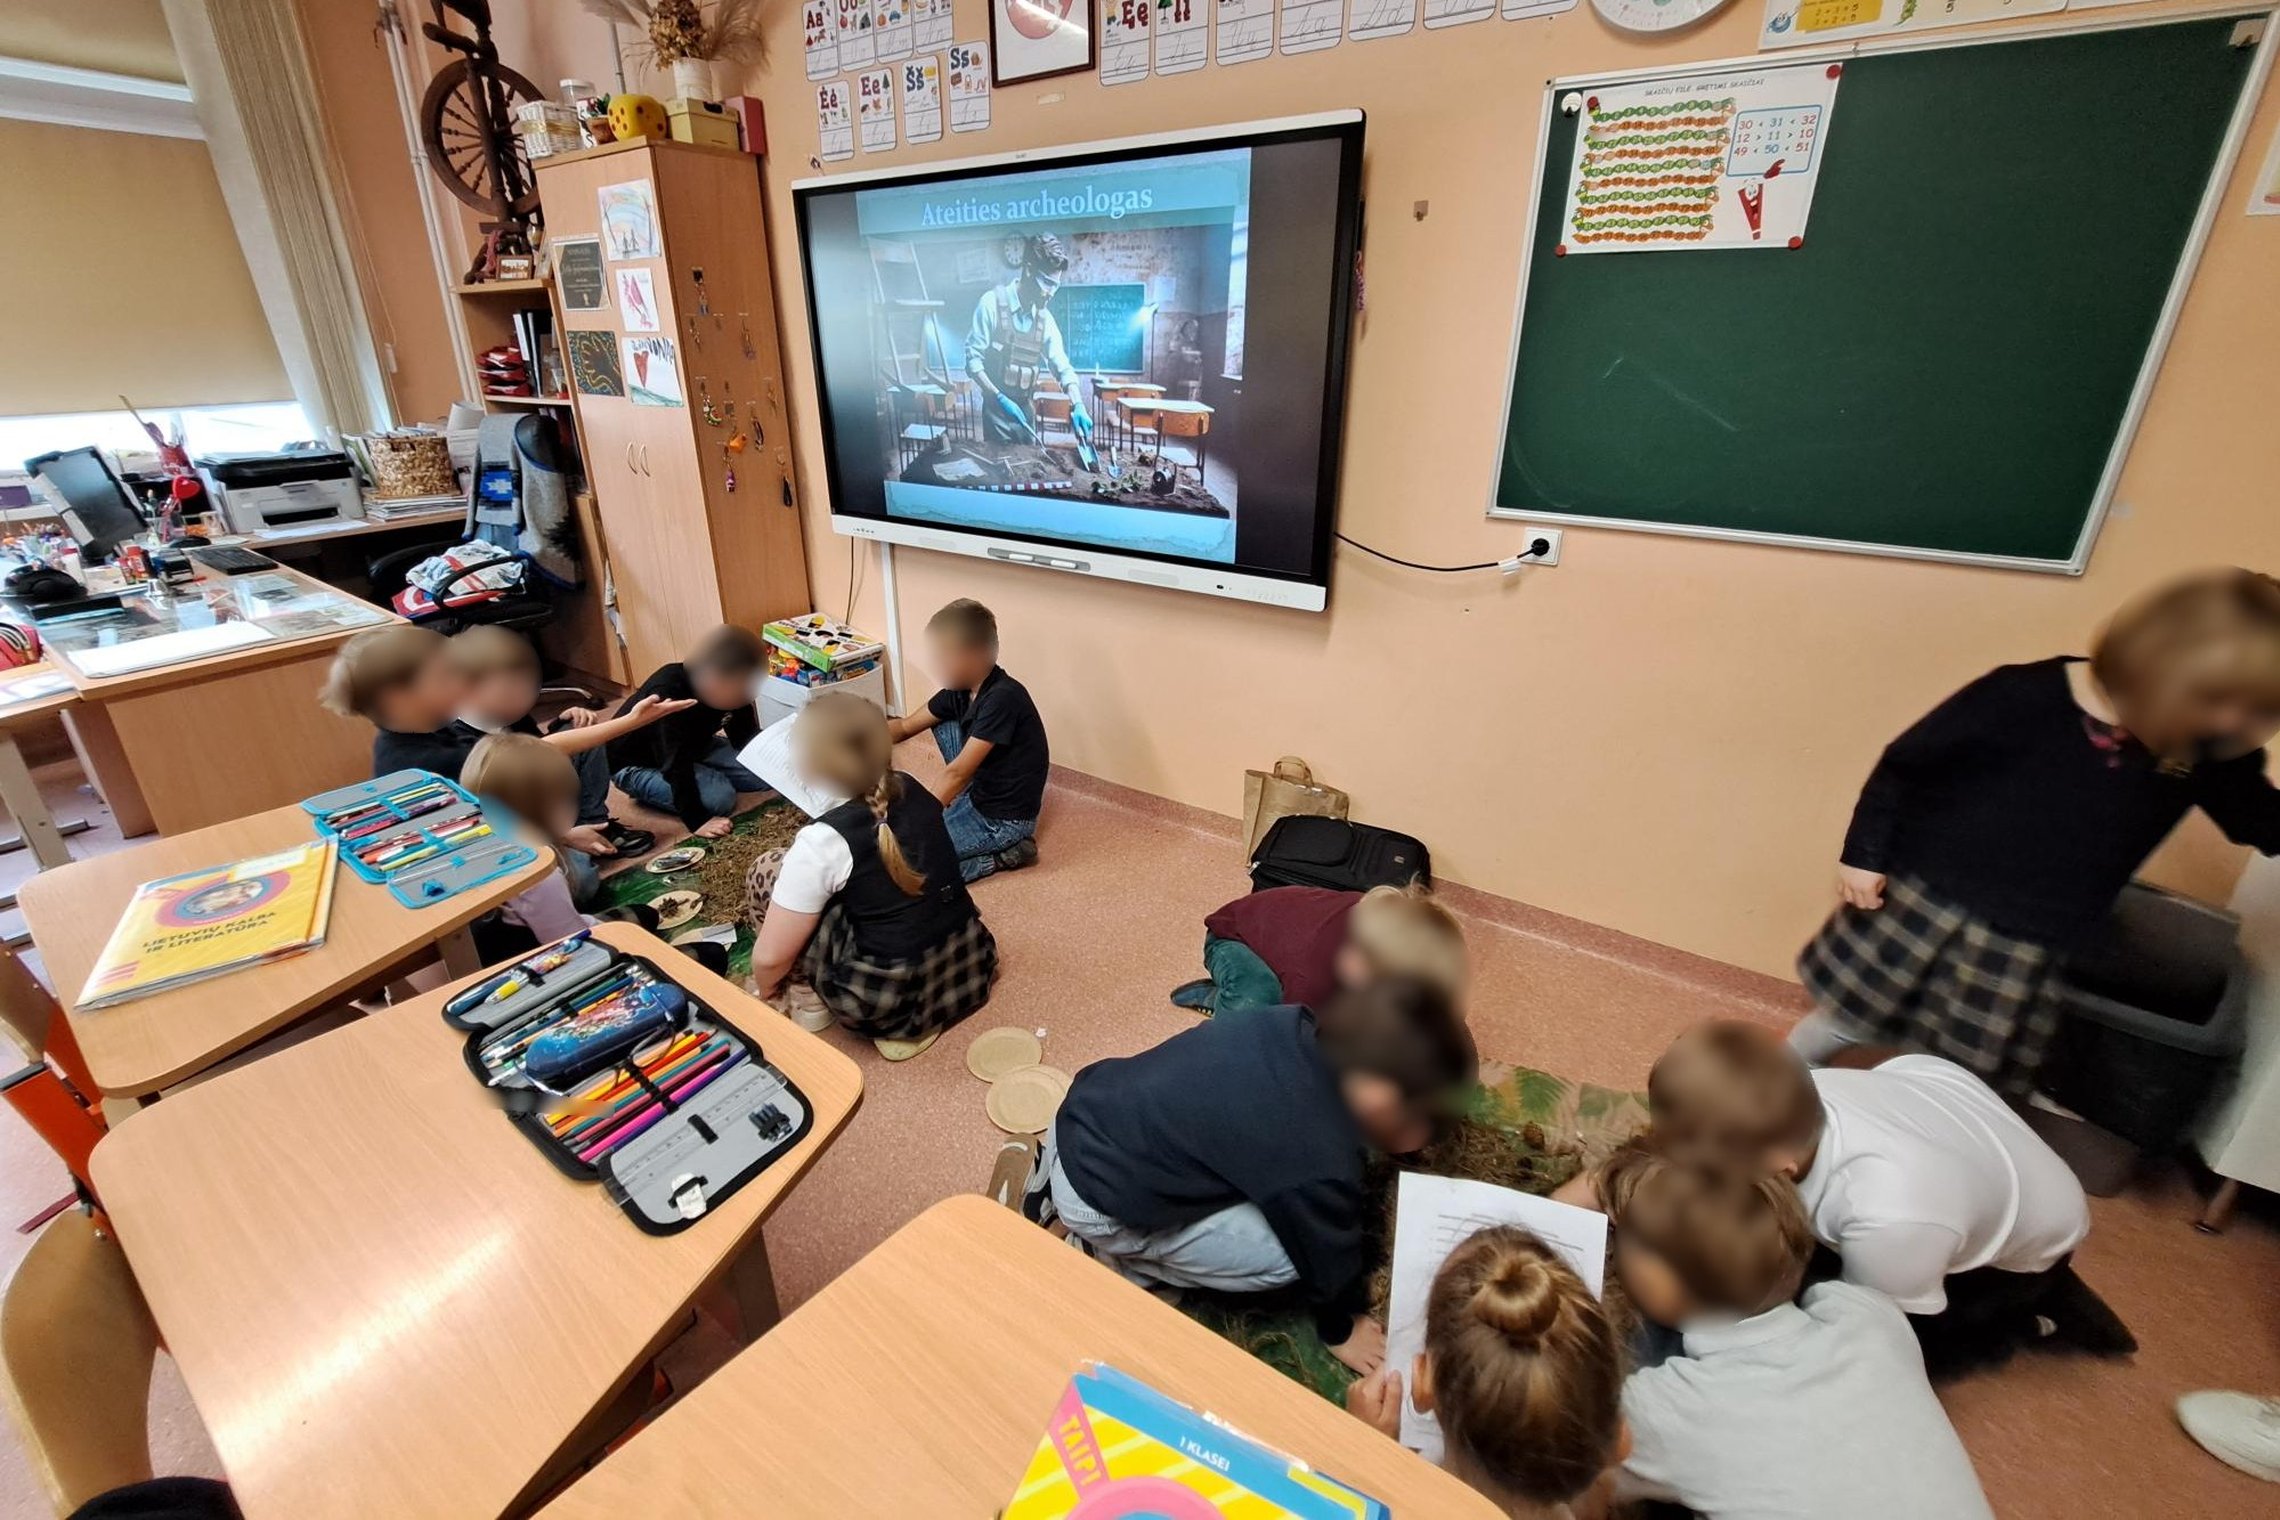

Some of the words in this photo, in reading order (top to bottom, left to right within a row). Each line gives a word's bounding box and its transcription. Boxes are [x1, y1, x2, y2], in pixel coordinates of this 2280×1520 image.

[951, 48, 970, 69] Ss
[860, 76, 881, 97] Ee
[906, 66, 925, 92] Šš
[1739, 120, 1753, 130] 30
[1770, 118, 1783, 127] 31
[1801, 115, 1816, 125] 32
[1737, 134, 1750, 143] 12
[1768, 131, 1780, 140] 11
[1800, 128, 1814, 138] 10
[1765, 144, 1779, 154] 50
[1795, 142, 1809, 152] 51
[921, 197, 1001, 227] Ateities
[1006, 184, 1153, 219] archeologas
[225, 911, 277, 928] KALBA
[1186, 1440, 1231, 1473] KLASEI
